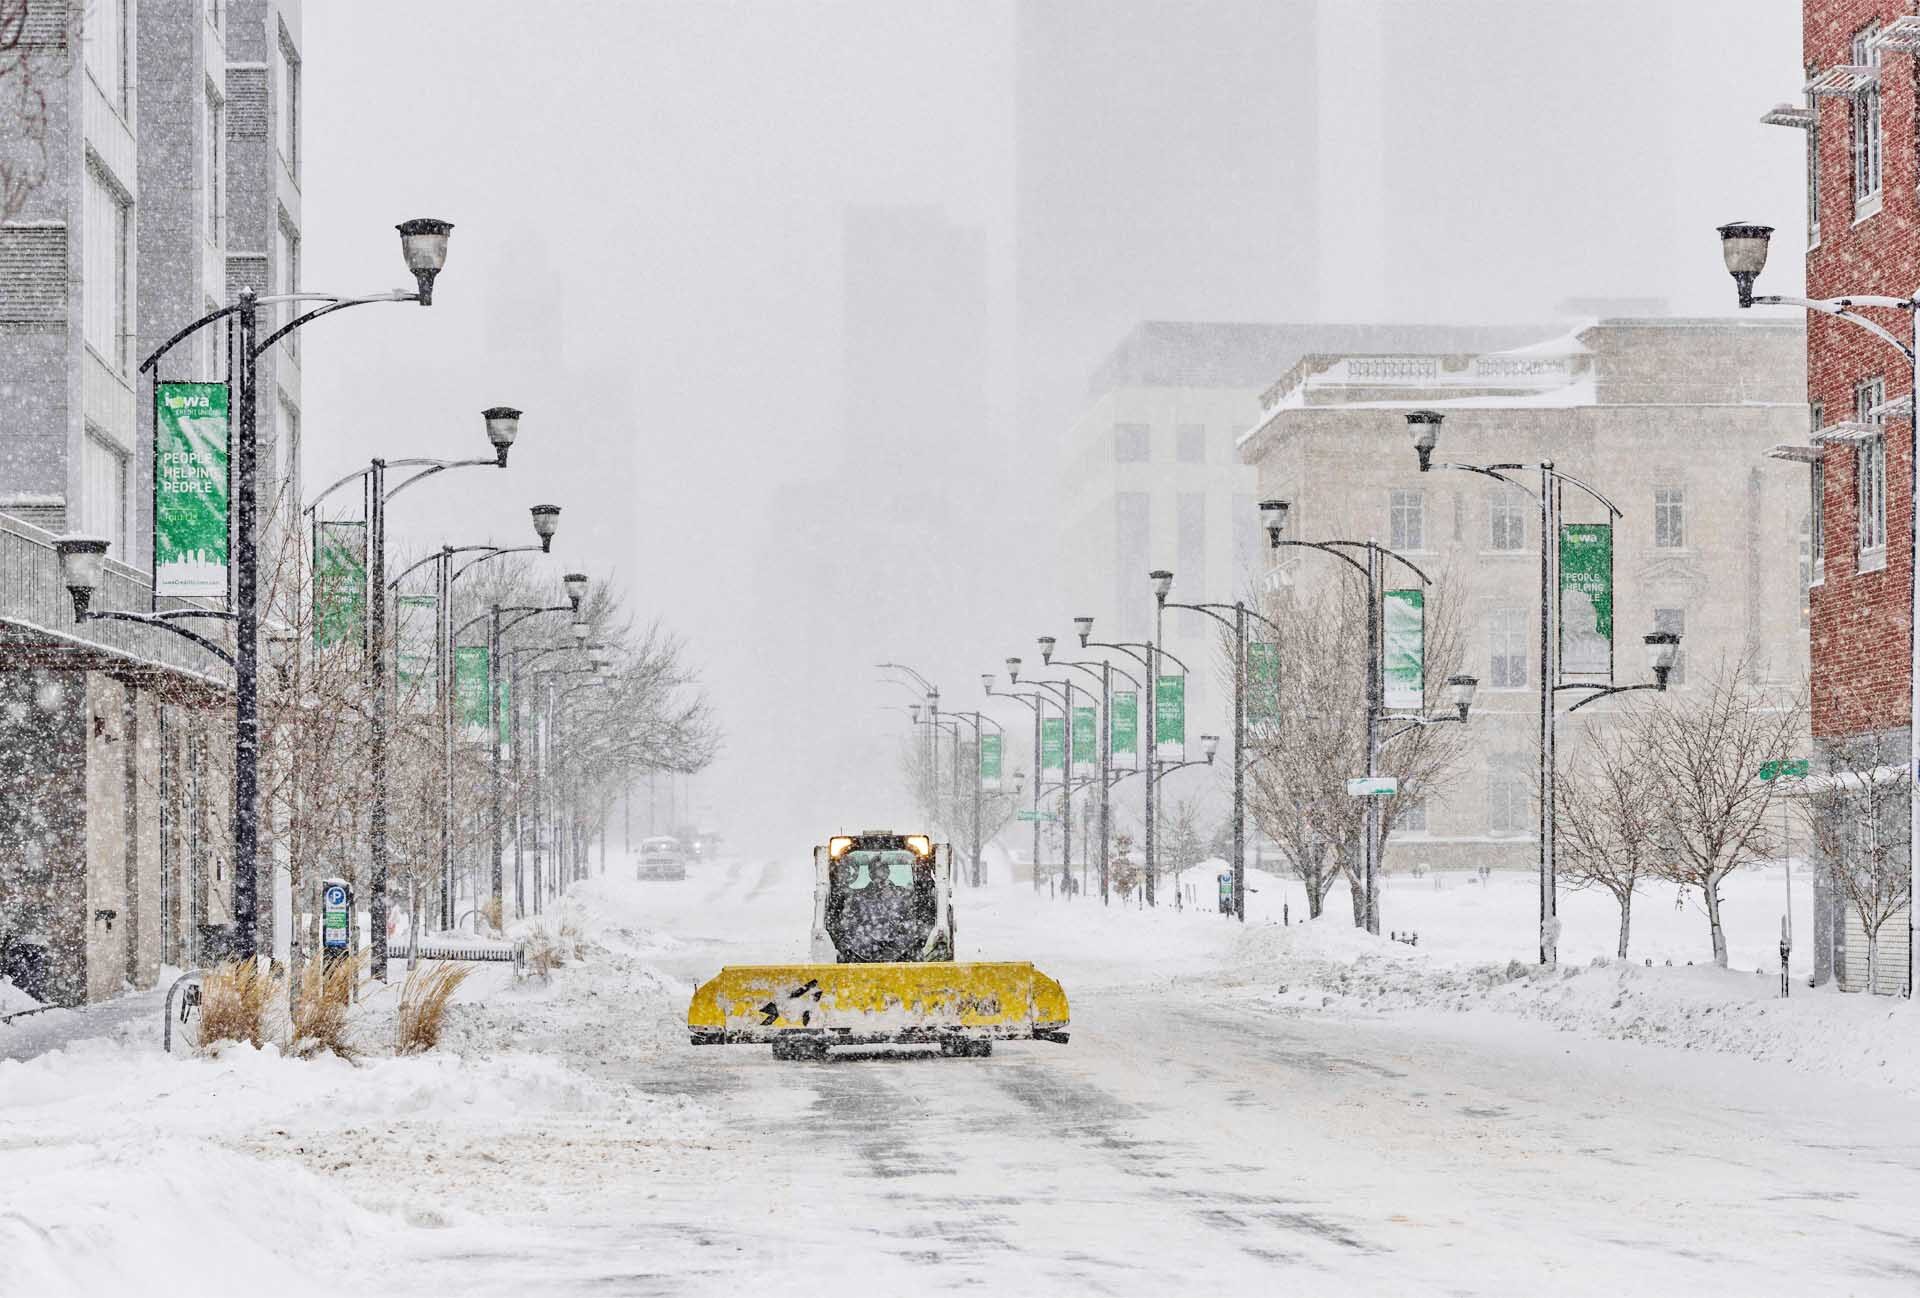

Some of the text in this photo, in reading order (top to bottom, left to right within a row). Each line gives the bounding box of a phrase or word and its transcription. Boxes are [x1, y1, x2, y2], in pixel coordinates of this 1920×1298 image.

[163, 452, 212, 464] PEOPLE
[163, 481, 213, 493] PEOPLE
[1566, 573, 1601, 582] PEOPLE
[1566, 583, 1604, 593] HELPING
